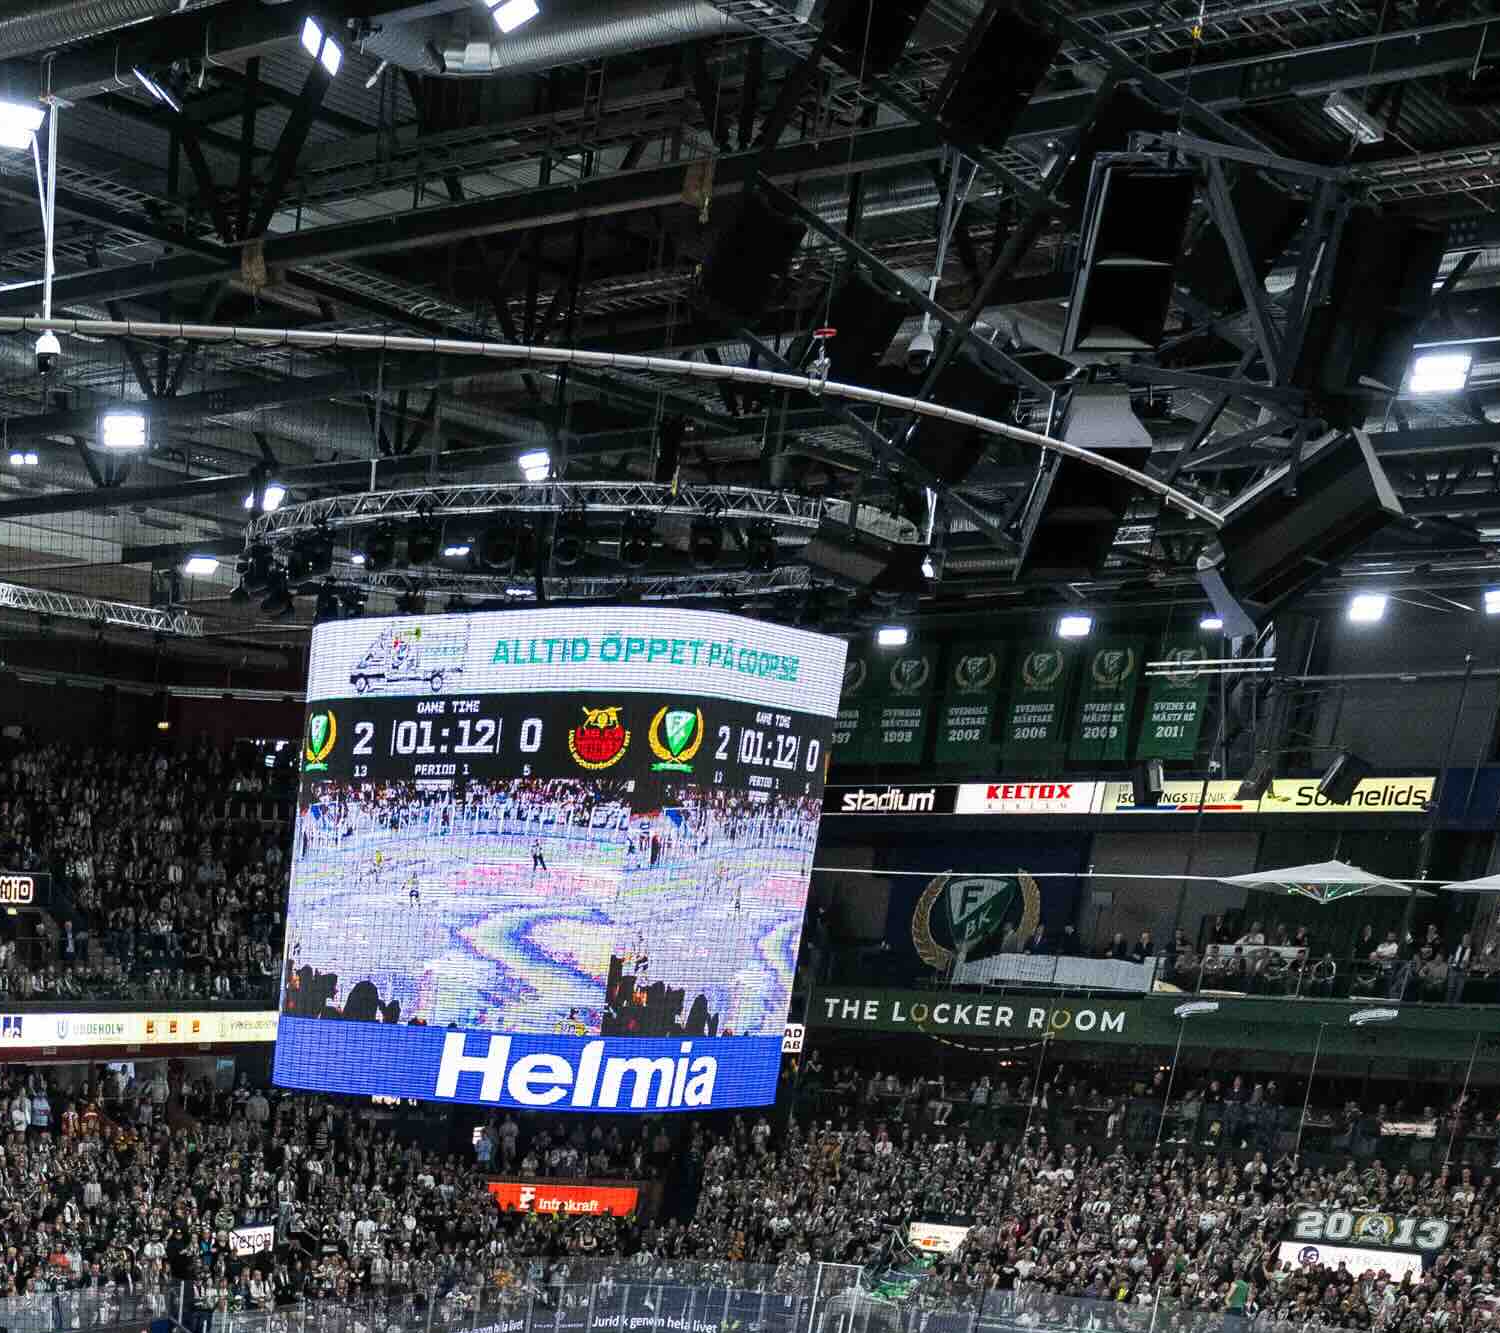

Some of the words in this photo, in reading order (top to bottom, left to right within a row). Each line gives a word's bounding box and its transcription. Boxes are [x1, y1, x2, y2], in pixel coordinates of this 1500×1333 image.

[492, 637, 589, 666] ALLTID
[600, 632, 702, 667] ÖPPET
[708, 639, 735, 670] PÅ
[417, 701, 447, 713] GAME
[450, 700, 480, 713] TIME
[353, 722, 374, 756] 2
[394, 719, 497, 755] 01:12
[518, 718, 543, 753] 0
[714, 726, 730, 760] 2
[742, 728, 799, 767] 01:12
[805, 737, 820, 773] 0
[415, 763, 456, 776] PERIOD
[842, 787, 937, 812] stadium
[985, 783, 1073, 800] KELTOX
[823, 997, 879, 1022] THE
[891, 1002, 1015, 1029] LOCKER
[1026, 1007, 1127, 1035] ROOM
[434, 1030, 718, 1109] Helmia
[591, 1310, 629, 1329] Juridk
